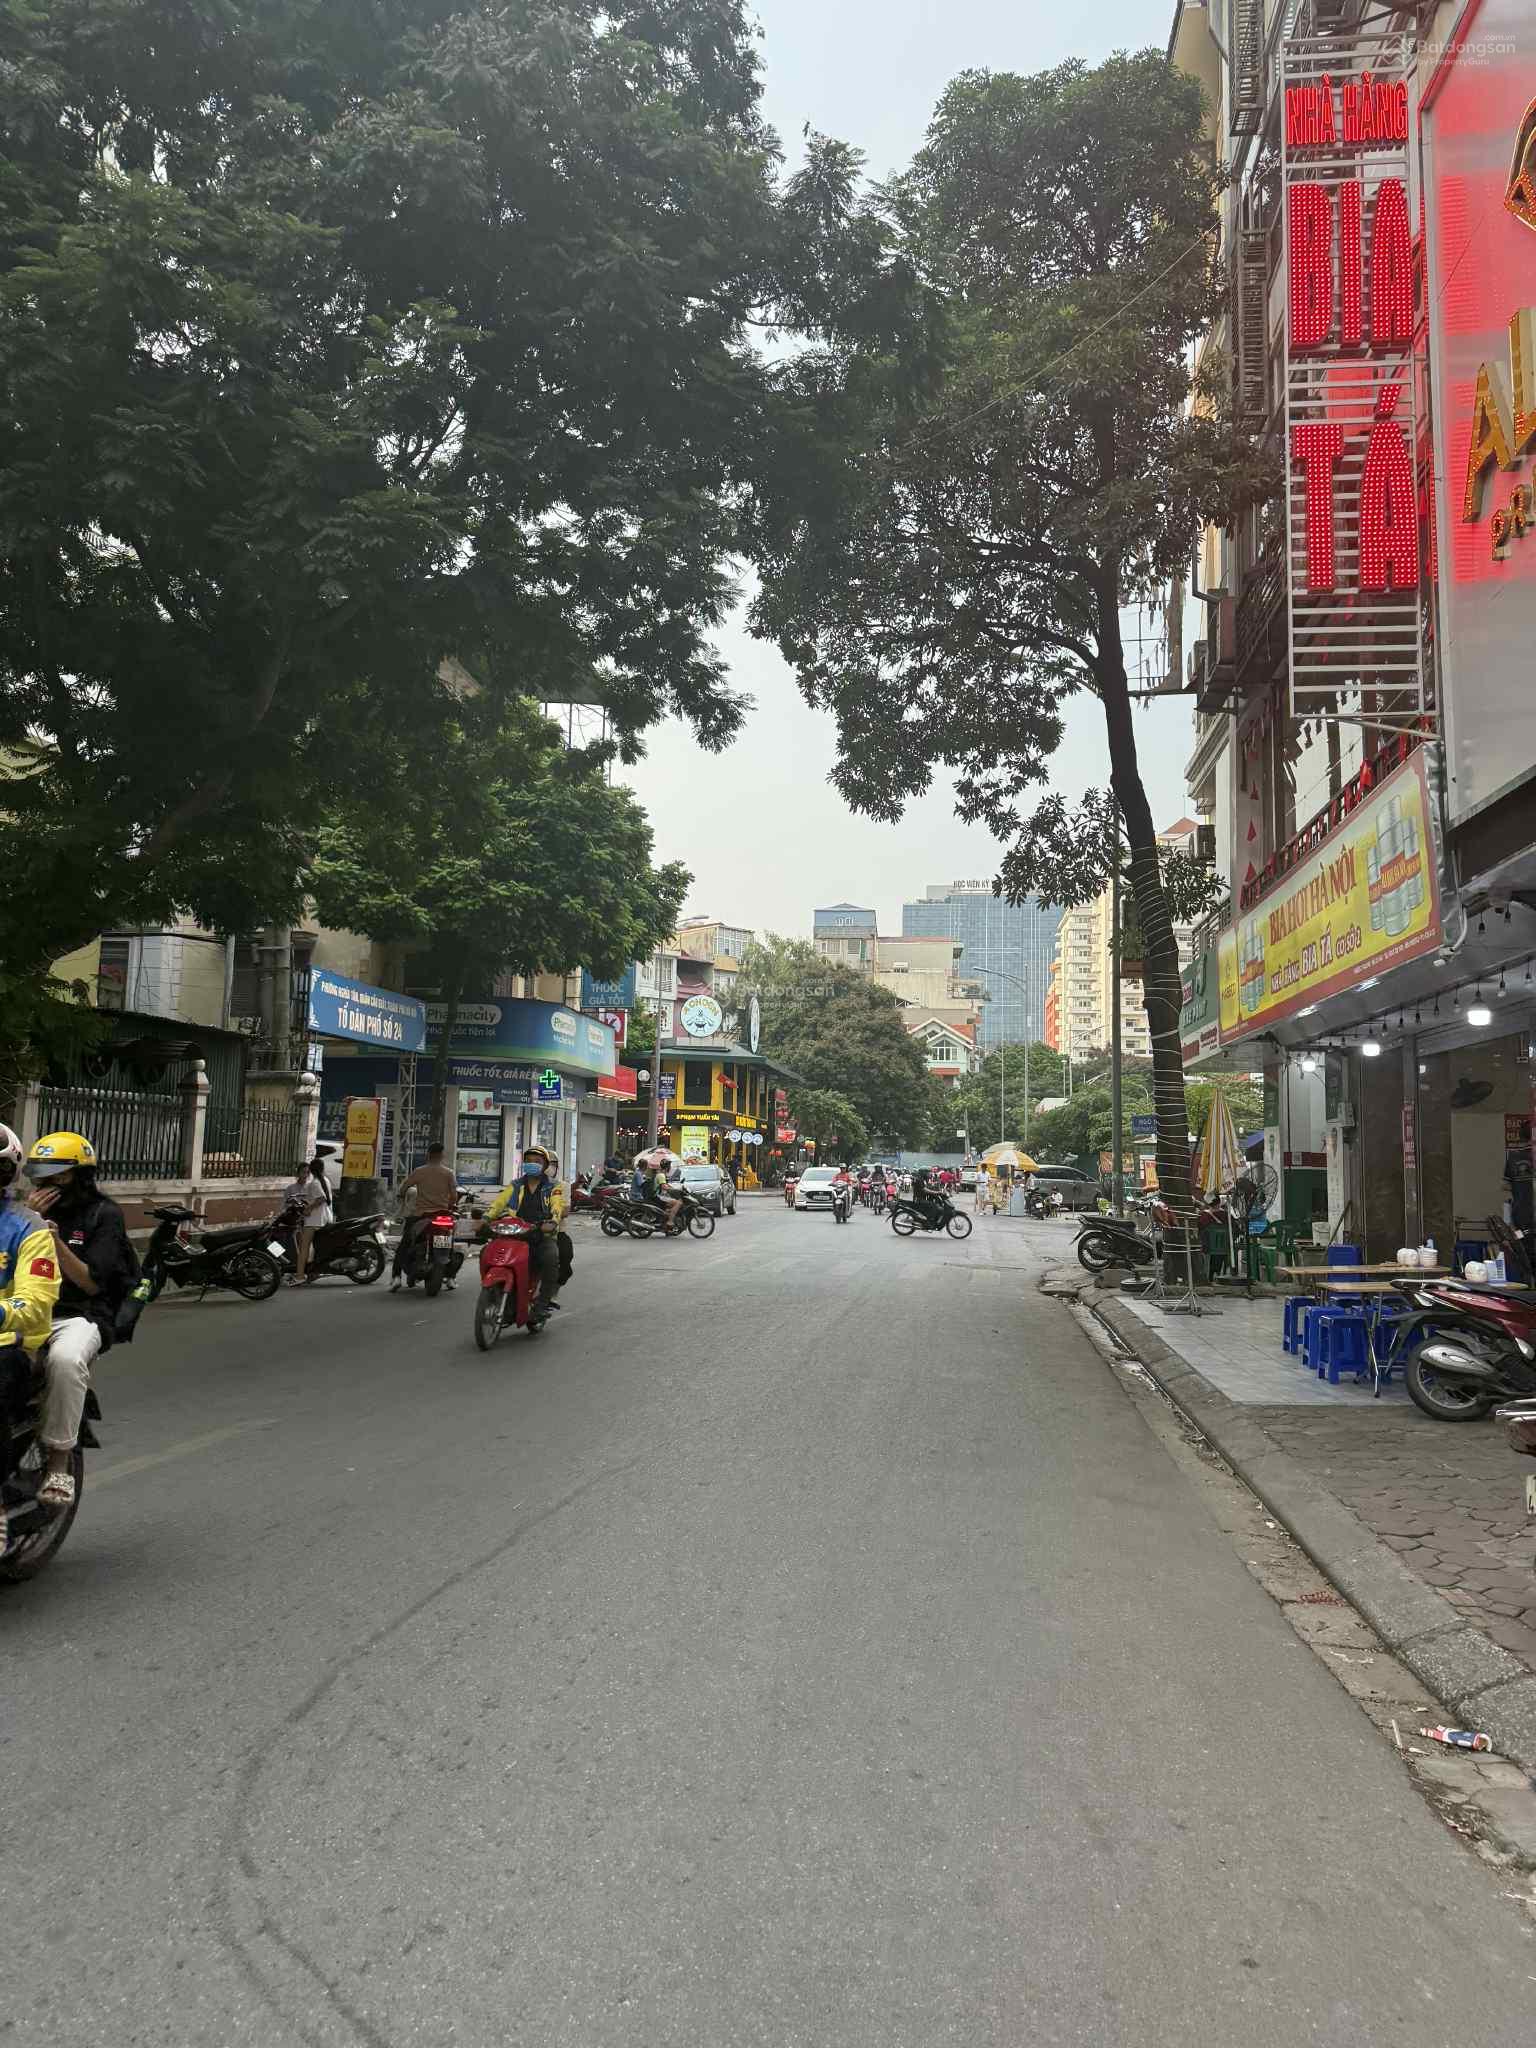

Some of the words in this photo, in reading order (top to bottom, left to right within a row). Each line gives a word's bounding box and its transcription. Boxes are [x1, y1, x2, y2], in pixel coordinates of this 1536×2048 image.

[1286, 71, 1336, 145] NHÀ
[1343, 71, 1408, 141] HÀNG
[1289, 178, 1414, 349] BIA
[1292, 384, 1419, 592] TÁ
[1269, 908, 1287, 945] BIA
[1310, 862, 1328, 918] HÀ
[1329, 843, 1358, 905] NỘI
[1301, 942, 1318, 977] BIA
[1320, 921, 1333, 966] TÁ
[349, 1008, 366, 1033] DÂN
[366, 1011, 382, 1037] PHỐ
[383, 1014, 393, 1040] SỐ
[427, 1005, 497, 1024] Phamacity
[452, 1064, 482, 1077] THUỐC
